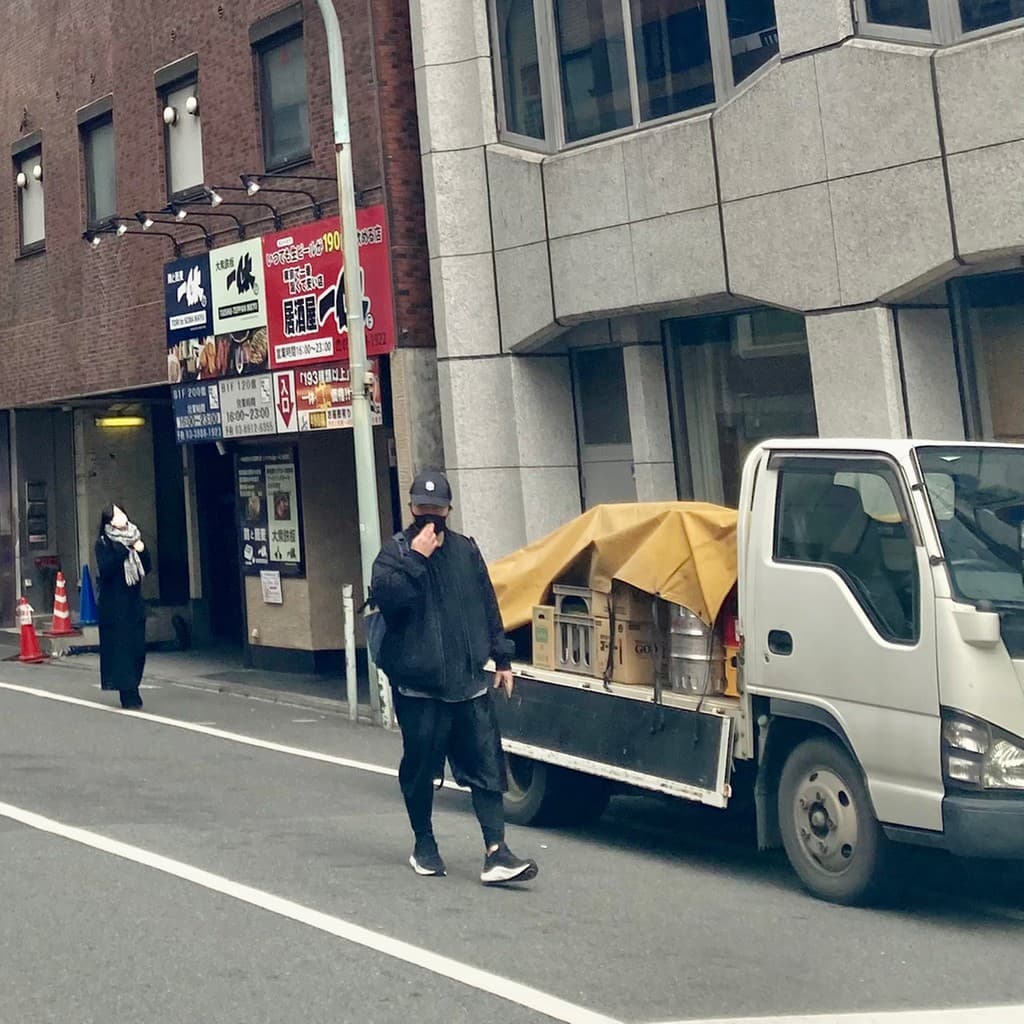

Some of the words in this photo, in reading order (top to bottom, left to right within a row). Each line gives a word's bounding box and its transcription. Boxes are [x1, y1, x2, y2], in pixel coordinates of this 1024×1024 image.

[282, 294, 318, 337] 居酒屋
[280, 378, 290, 414] 入口
